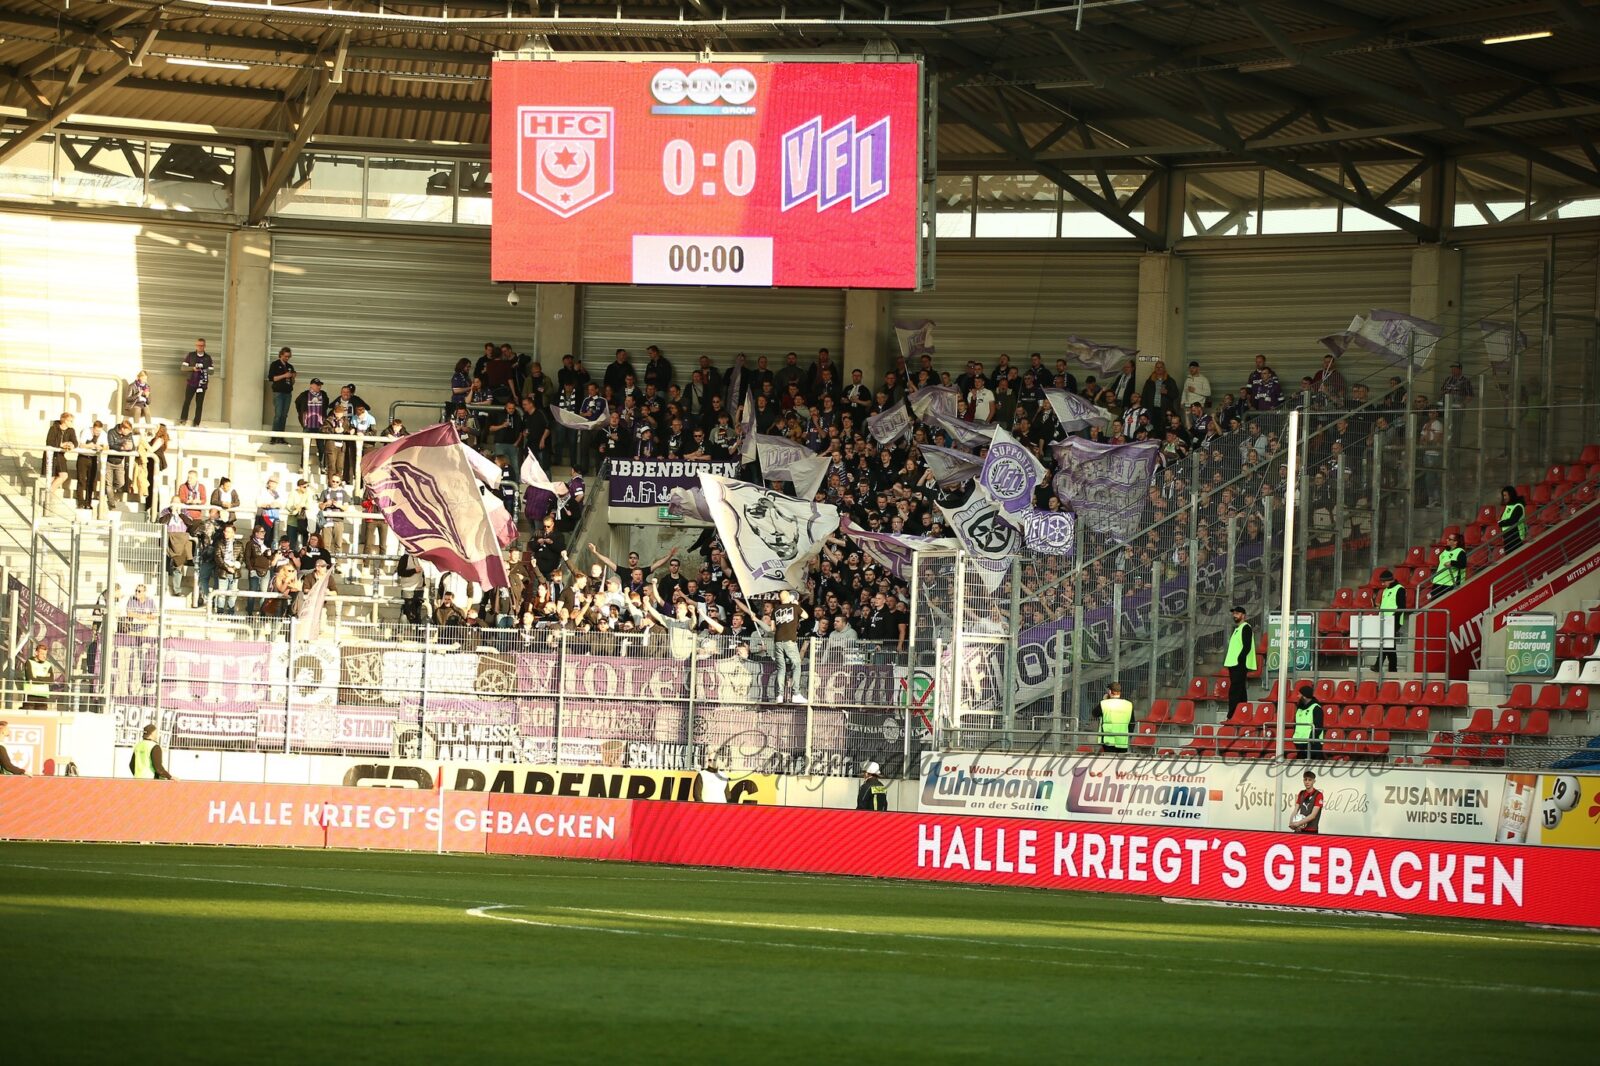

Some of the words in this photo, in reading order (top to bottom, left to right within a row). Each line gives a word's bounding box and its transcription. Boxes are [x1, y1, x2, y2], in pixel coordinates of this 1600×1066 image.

[530, 116, 602, 135] HFC
[662, 139, 757, 196] 0:0
[784, 120, 885, 205] VFL
[668, 244, 745, 273] 00:00
[992, 446, 1036, 478] SUPPORTER
[1508, 641, 1551, 651] Entsorgung
[1513, 630, 1539, 639] Wasser
[1540, 630, 1547, 639] &
[920, 761, 1054, 808] Lührmann
[1065, 766, 1206, 816] Lührmann
[1384, 785, 1489, 808] ZUSAMMEN
[1553, 777, 1567, 800] 19
[970, 801, 982, 810] an
[985, 800, 1007, 811] der
[1010, 802, 1049, 813] Saline
[1338, 788, 1369, 813] Pils
[208, 800, 293, 825] HALLE
[454, 808, 616, 840] GEBACKEN
[1117, 808, 1133, 816] an
[1136, 806, 1157, 816] der
[1160, 808, 1202, 820] Saline
[1406, 810, 1447, 825] WIRD'S
[1450, 812, 1484, 826] EDEL.
[1543, 808, 1557, 826] 15
[917, 823, 1038, 875] HALLE
[1263, 844, 1524, 908] GEBACKEN
